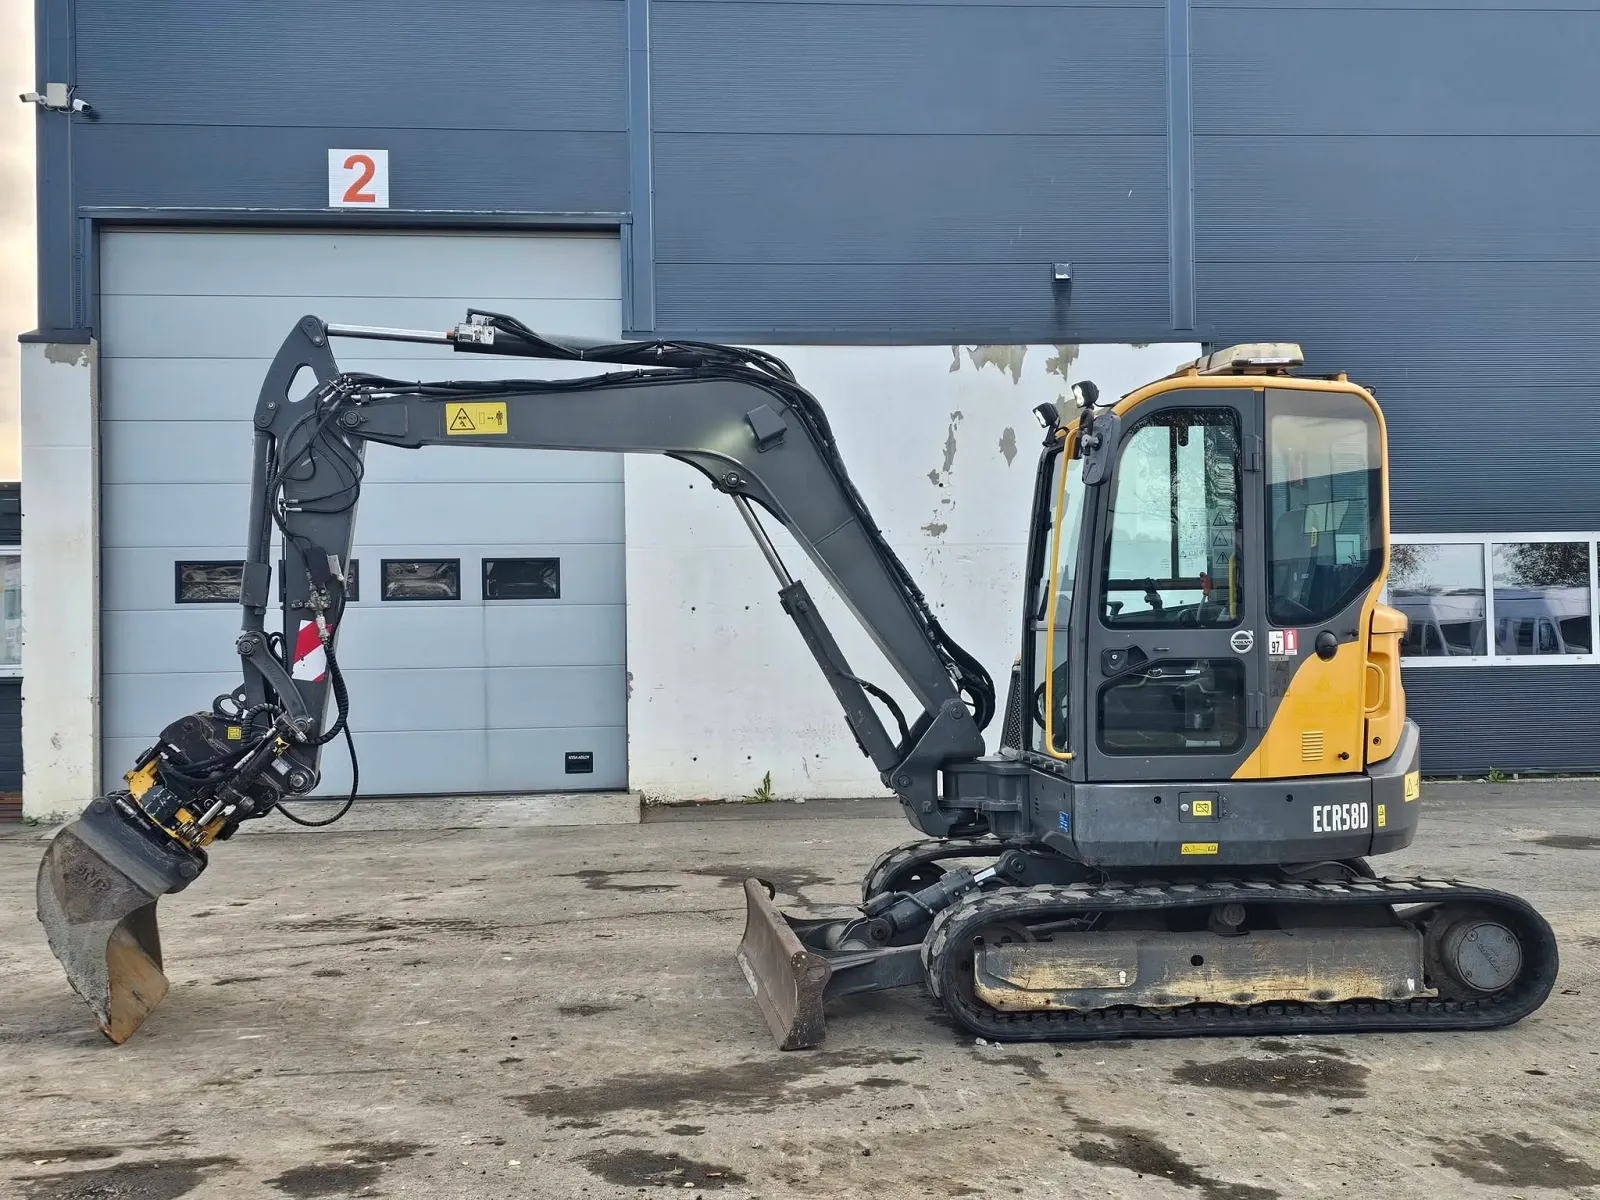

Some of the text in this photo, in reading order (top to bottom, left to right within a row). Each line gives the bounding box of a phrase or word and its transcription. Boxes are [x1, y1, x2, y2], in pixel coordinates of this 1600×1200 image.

[343, 154, 376, 203] 2
[1271, 641, 1280, 653] 97
[1313, 802, 1369, 832] ECR58D
